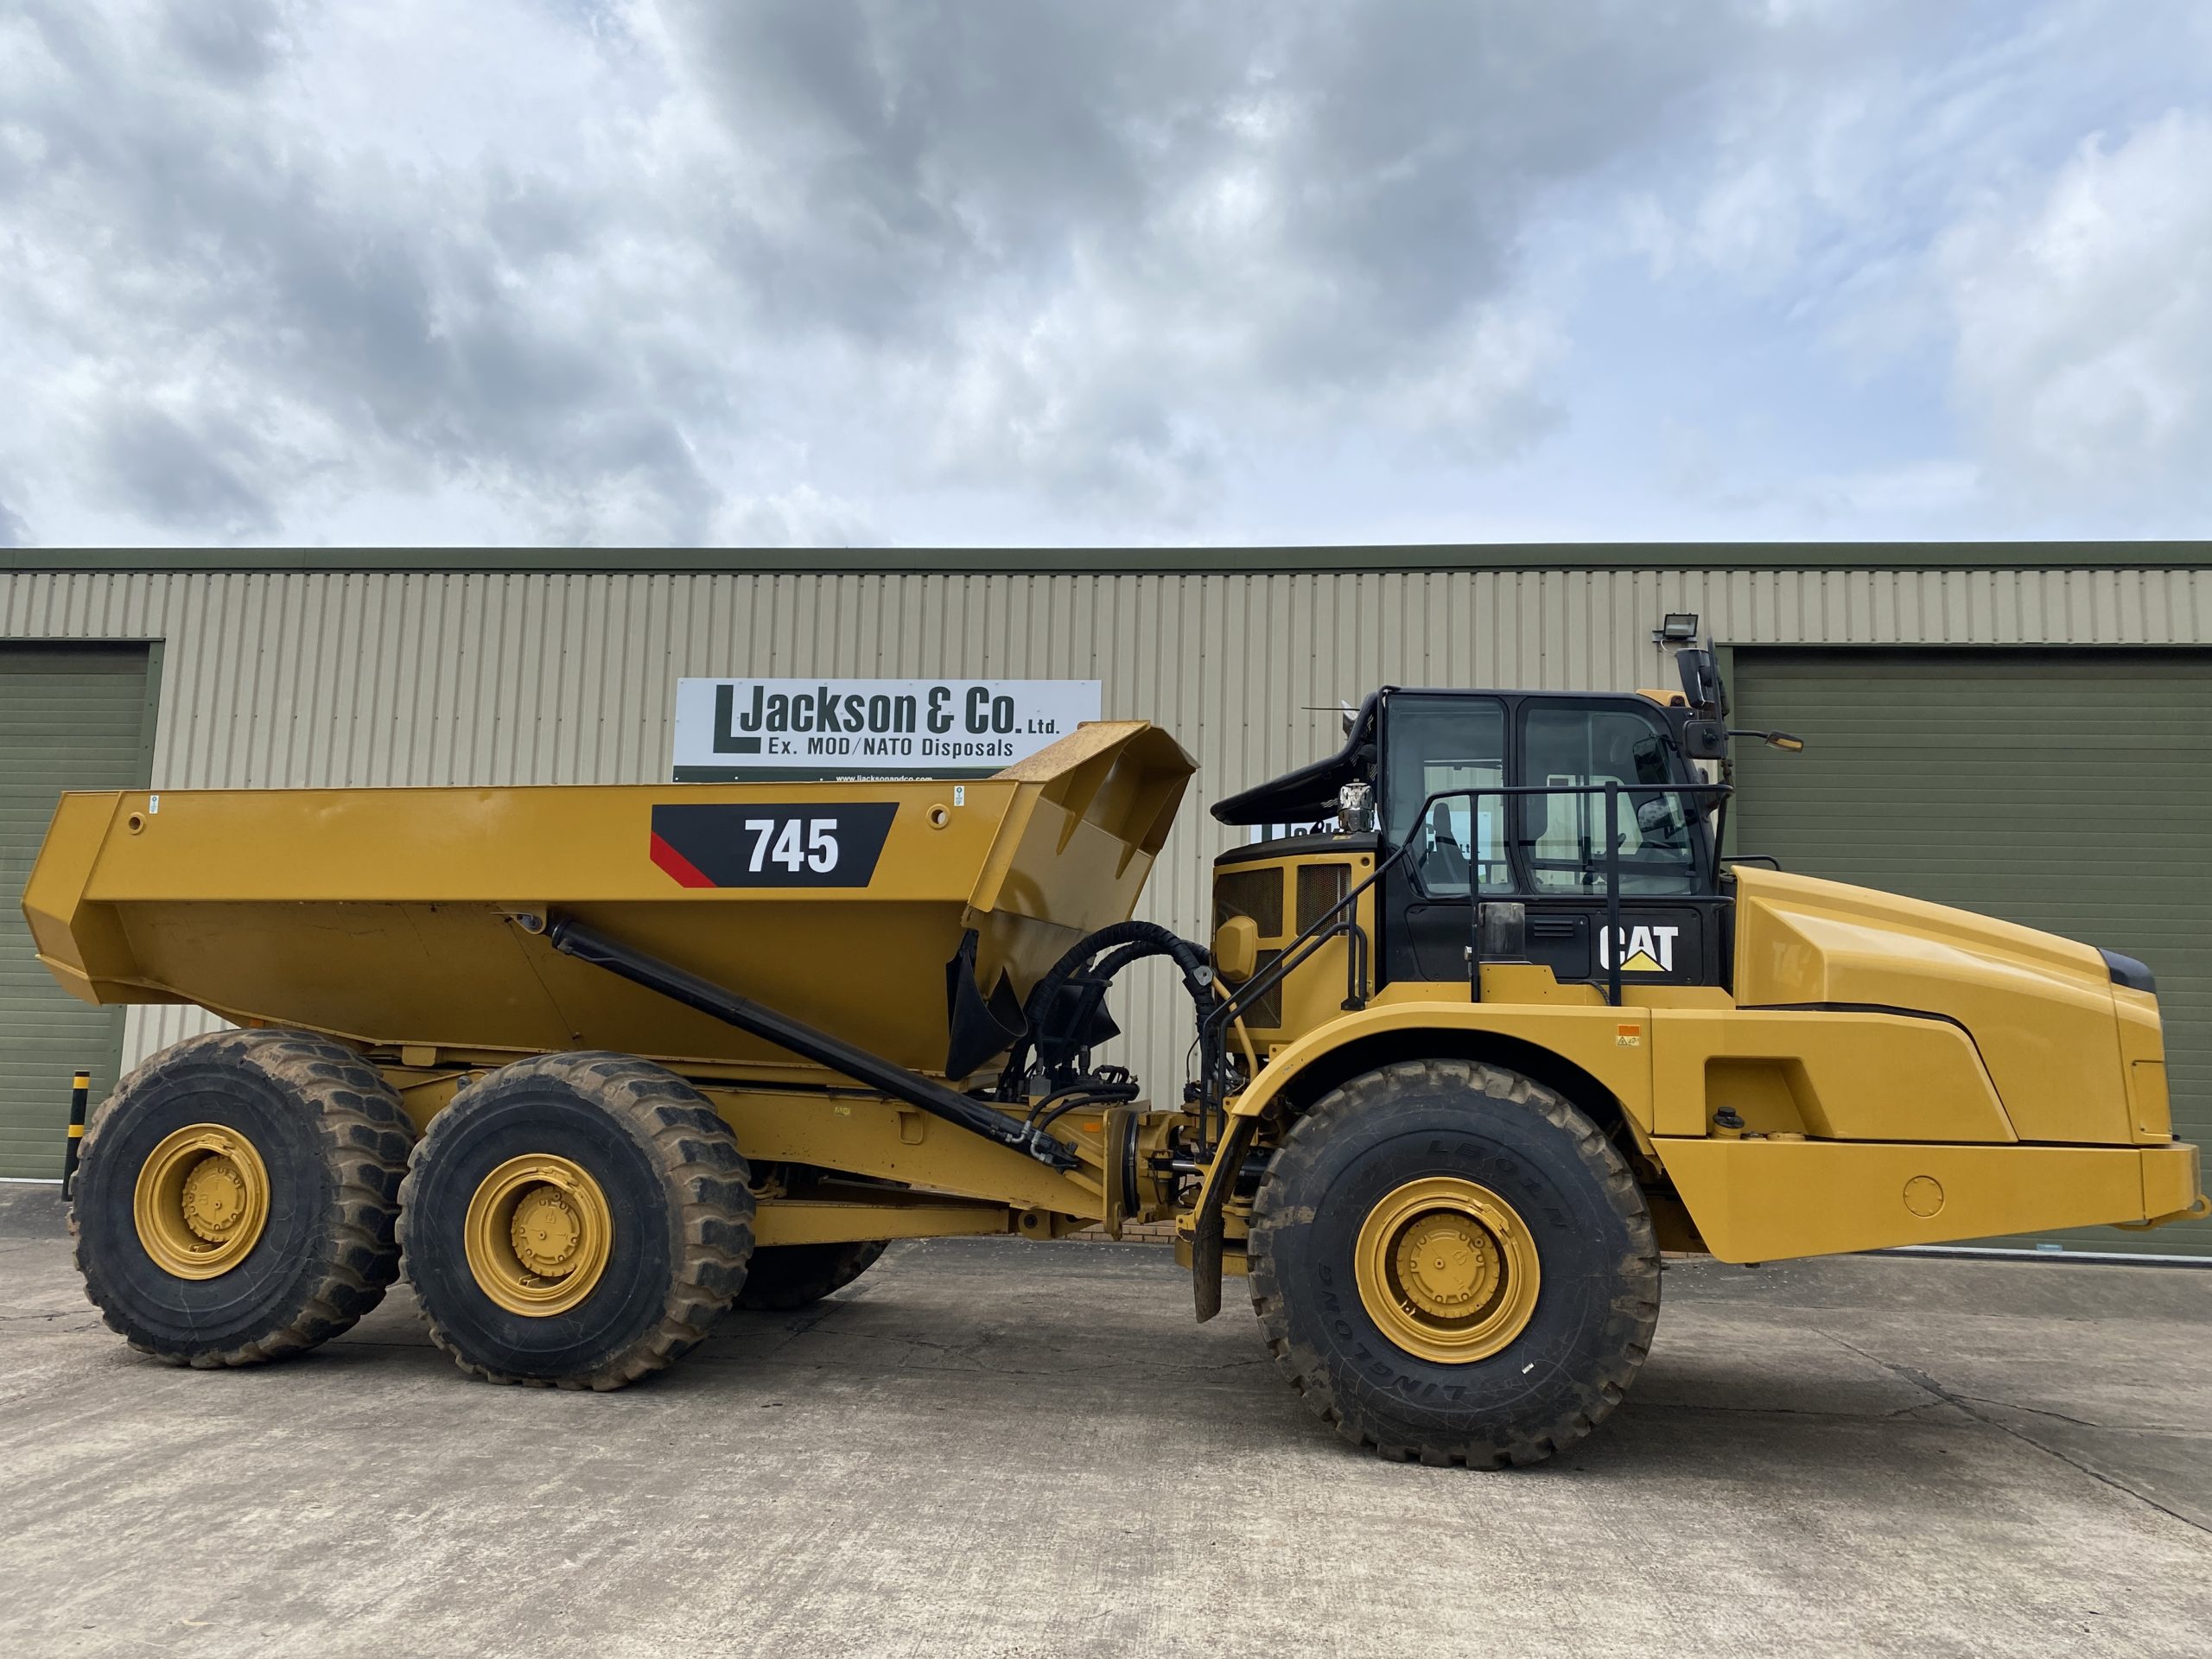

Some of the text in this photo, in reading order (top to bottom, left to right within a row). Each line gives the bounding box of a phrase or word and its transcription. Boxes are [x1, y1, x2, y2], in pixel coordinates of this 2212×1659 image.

[927, 686, 954, 734] &
[965, 686, 1022, 734] Co.
[1028, 719, 1060, 734] Ltd.
[768, 737, 798, 754] Ex.
[922, 738, 1014, 759] Disposals
[745, 818, 839, 873] 745
[1599, 925, 1679, 972] CAT
